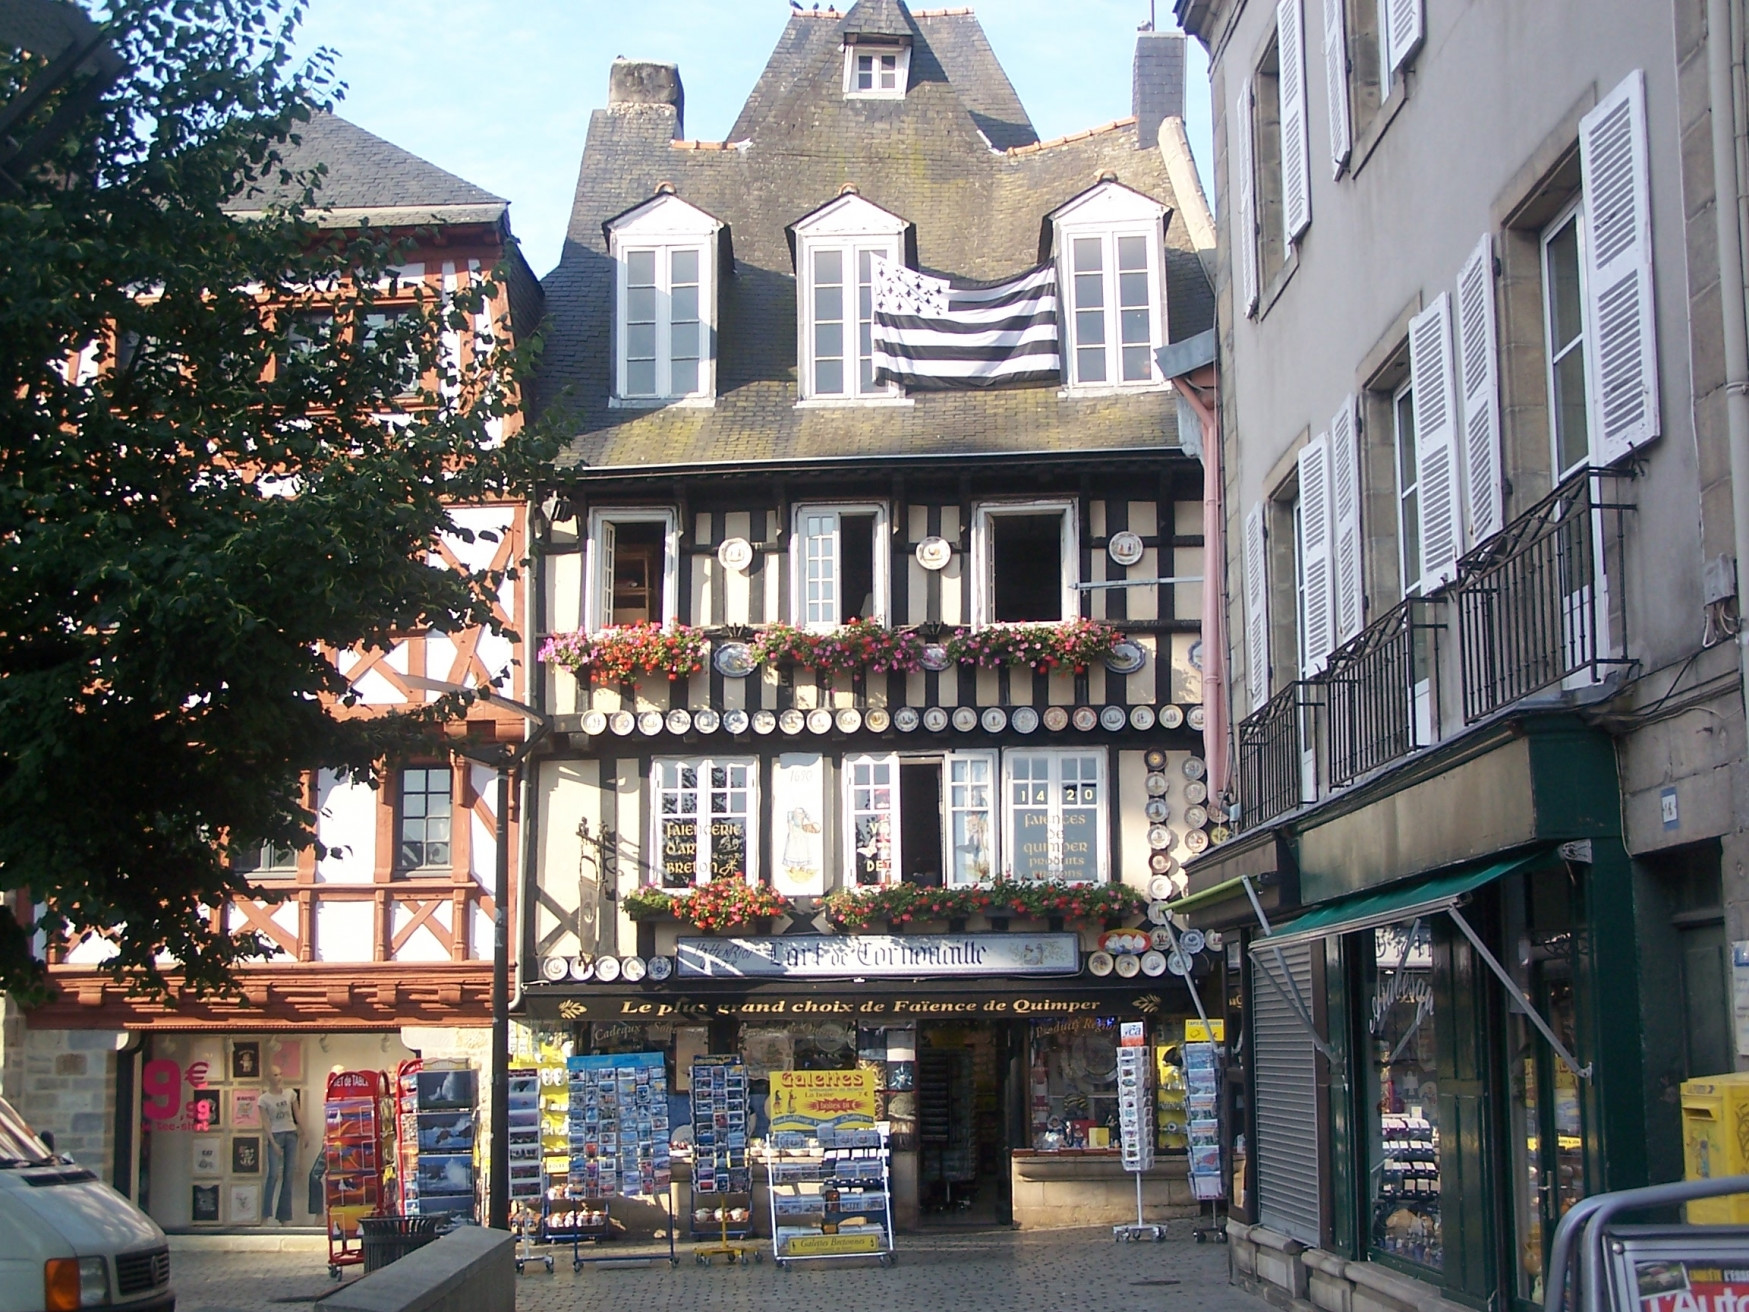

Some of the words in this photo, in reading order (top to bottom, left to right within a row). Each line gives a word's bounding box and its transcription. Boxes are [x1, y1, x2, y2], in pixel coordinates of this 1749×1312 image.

[856, 940, 987, 966] Cornouaille
[620, 1000, 652, 1013] Le
[656, 1000, 708, 1016] plus
[715, 1000, 786, 1015] grand
[791, 1000, 854, 1013] choix
[859, 1000, 885, 1013] de
[892, 1000, 977, 1013] Faïence
[983, 999, 1007, 1012] de
[1012, 998, 1101, 1014] Quimper
[782, 1072, 864, 1088] Galettes
